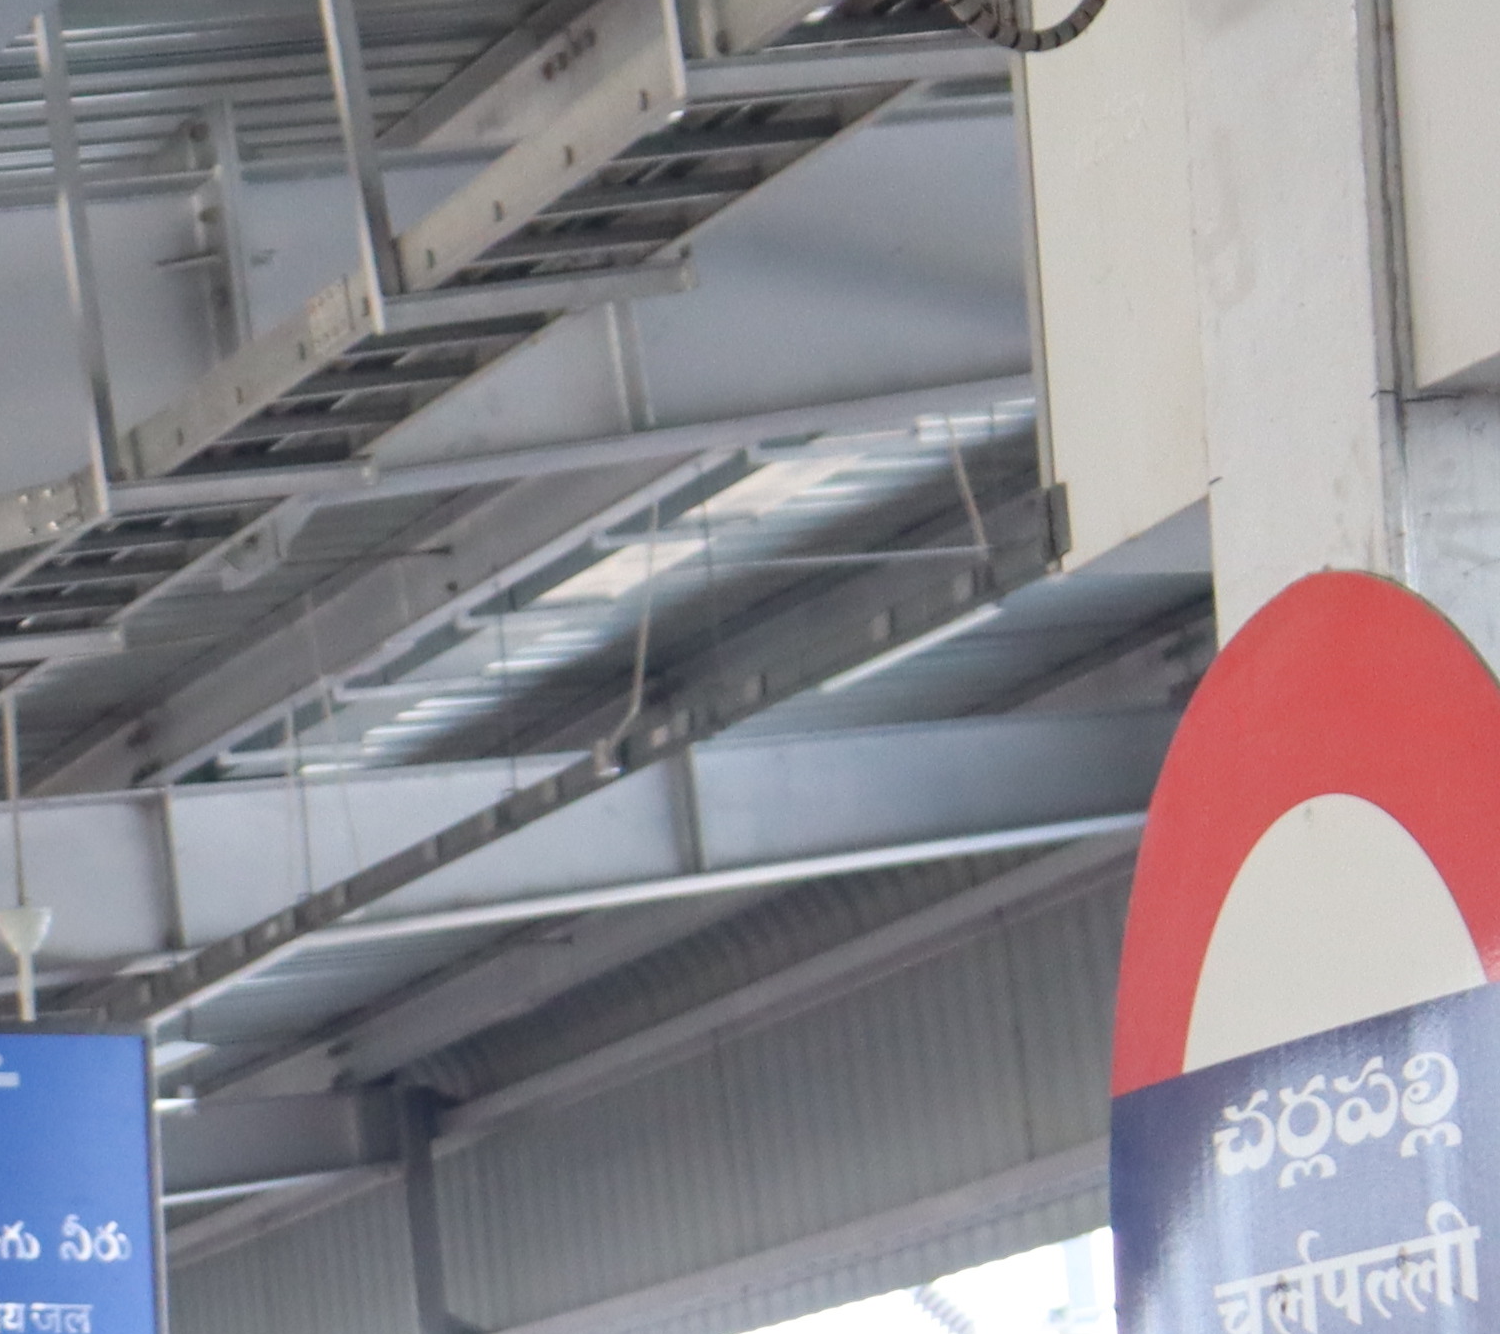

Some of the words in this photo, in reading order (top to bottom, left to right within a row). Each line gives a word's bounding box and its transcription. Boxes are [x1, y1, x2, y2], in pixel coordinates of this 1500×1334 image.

[1214, 1052, 1462, 1188] చర్లపల్లి
[61, 1215, 126, 1262] నీరు
[31, 1303, 91, 1333] जल
